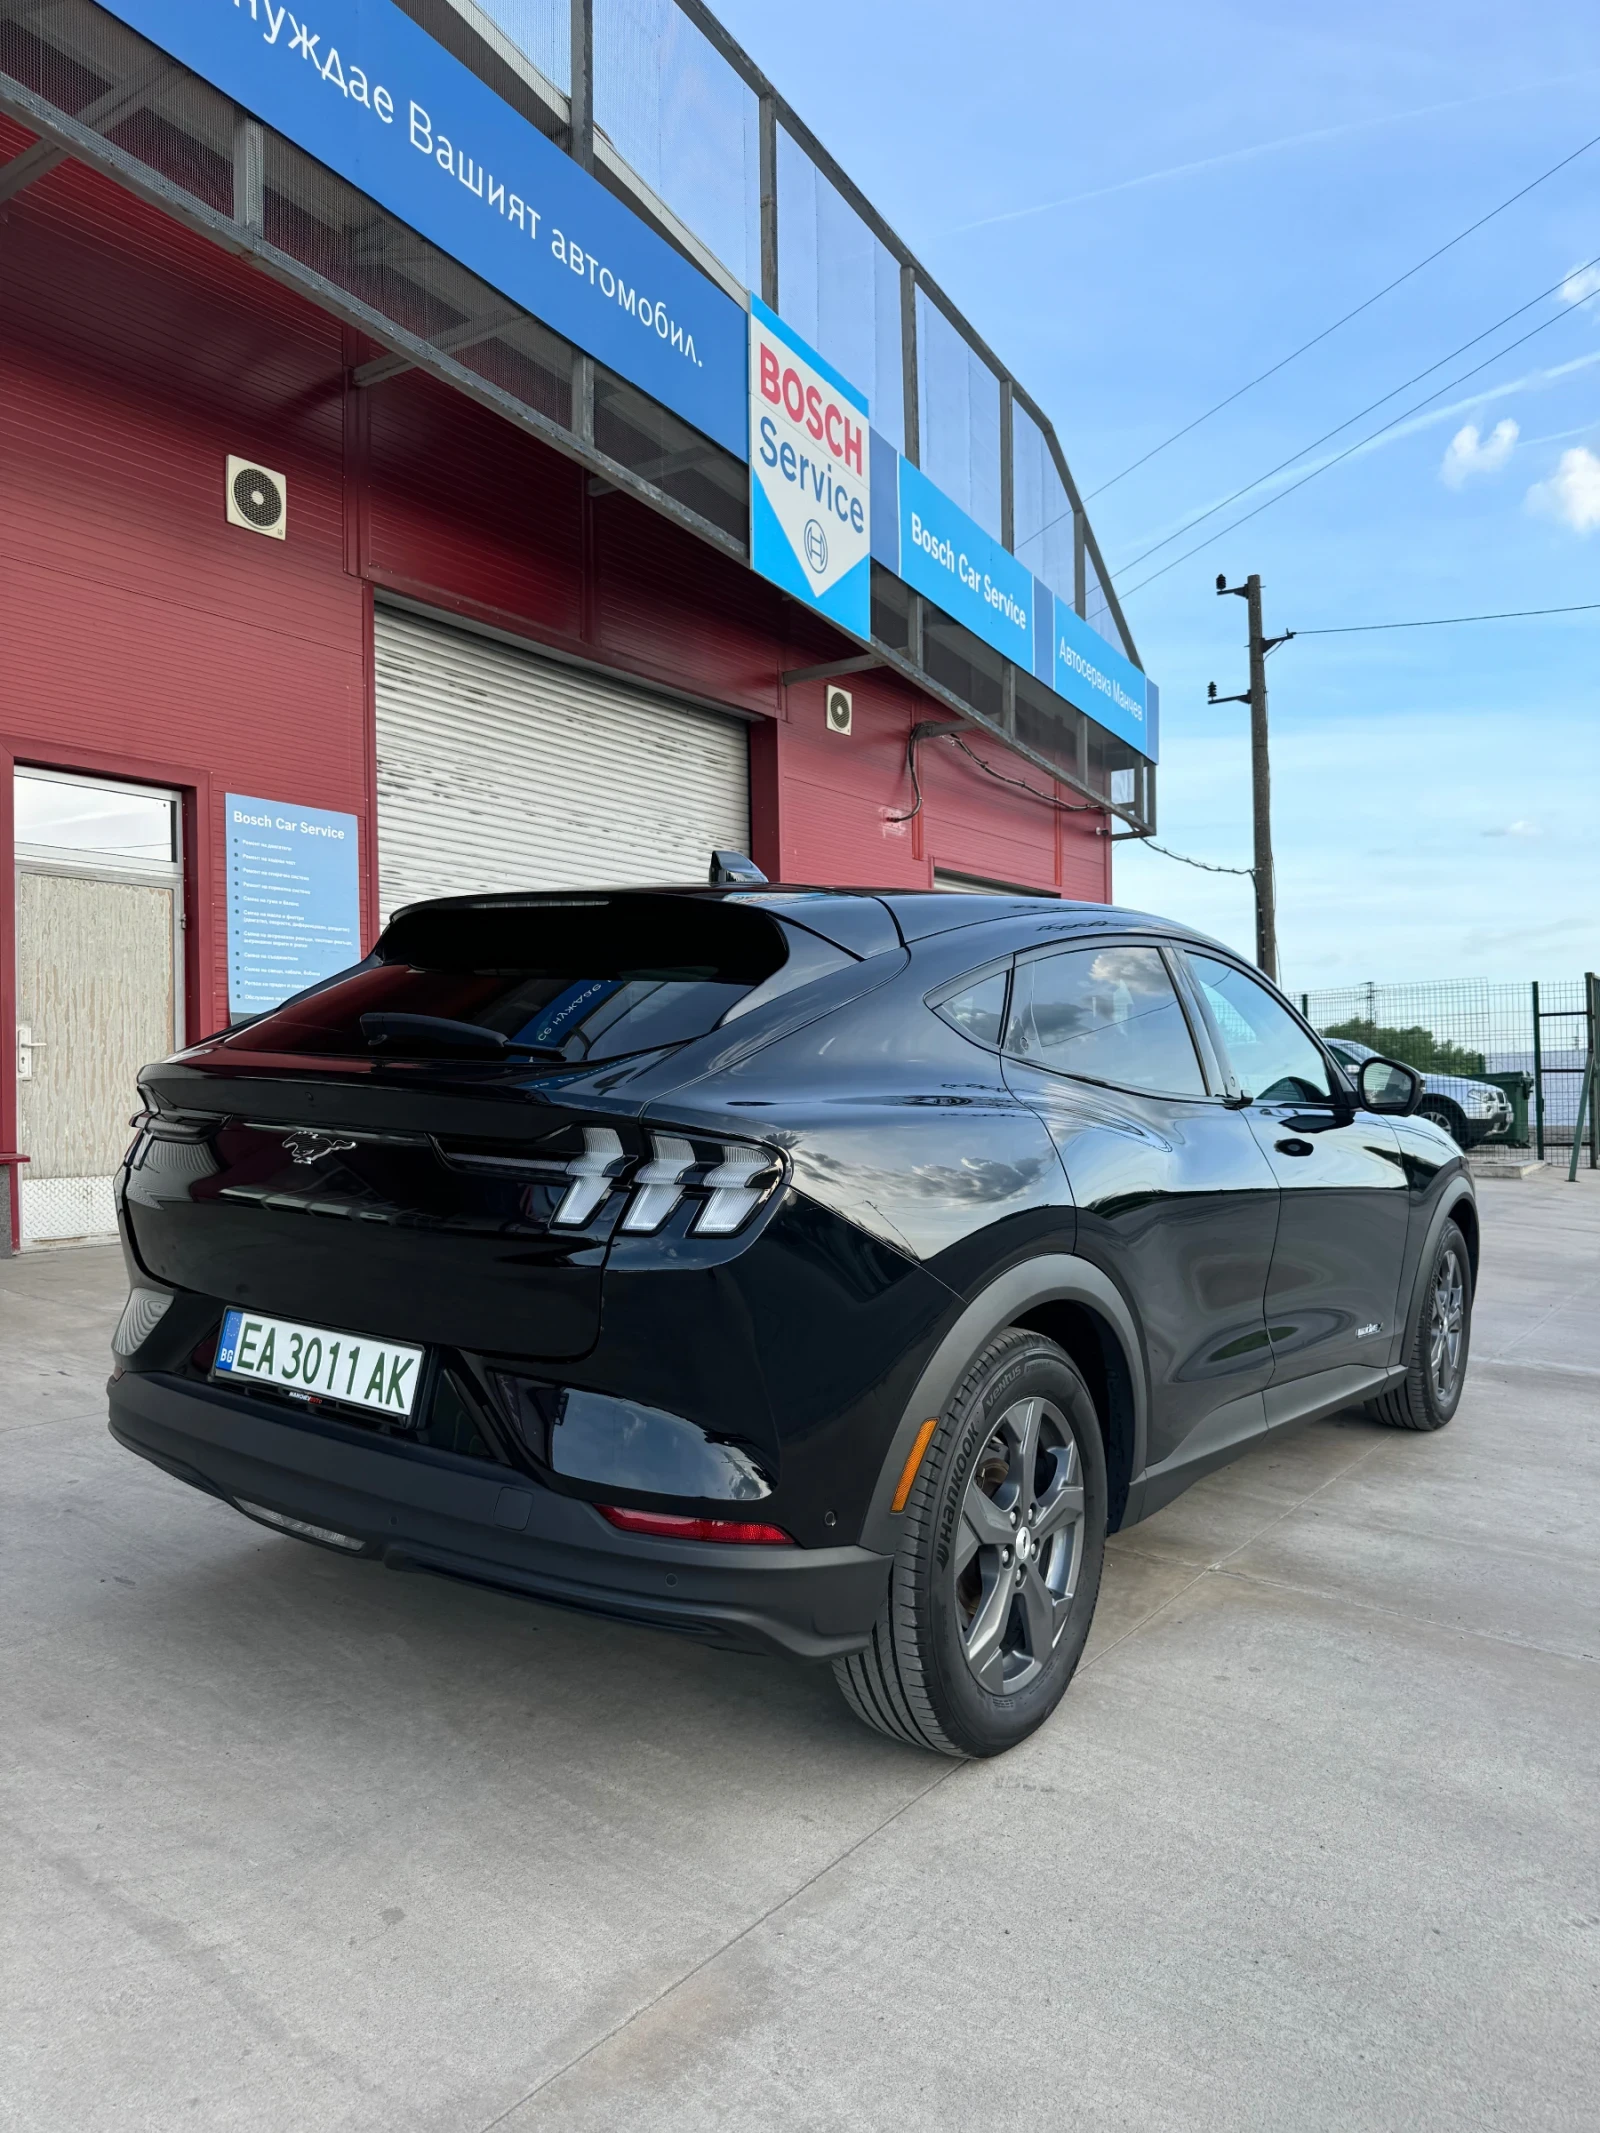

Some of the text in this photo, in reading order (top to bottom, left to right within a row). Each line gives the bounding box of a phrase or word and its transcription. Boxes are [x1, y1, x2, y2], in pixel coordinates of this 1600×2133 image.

[409, 100, 541, 240] Вашият
[551, 227, 704, 368] автомобил.
[760, 342, 863, 476] BOSCH
[759, 416, 864, 533] Service
[911, 511, 1027, 630] Bosch Car Service
[1058, 636, 1143, 722] Автосервиз Манчев
[233, 810, 345, 839] Bosch Car Service
[219, 1347, 234, 1364] BG
[281, 1332, 361, 1396] 3011
